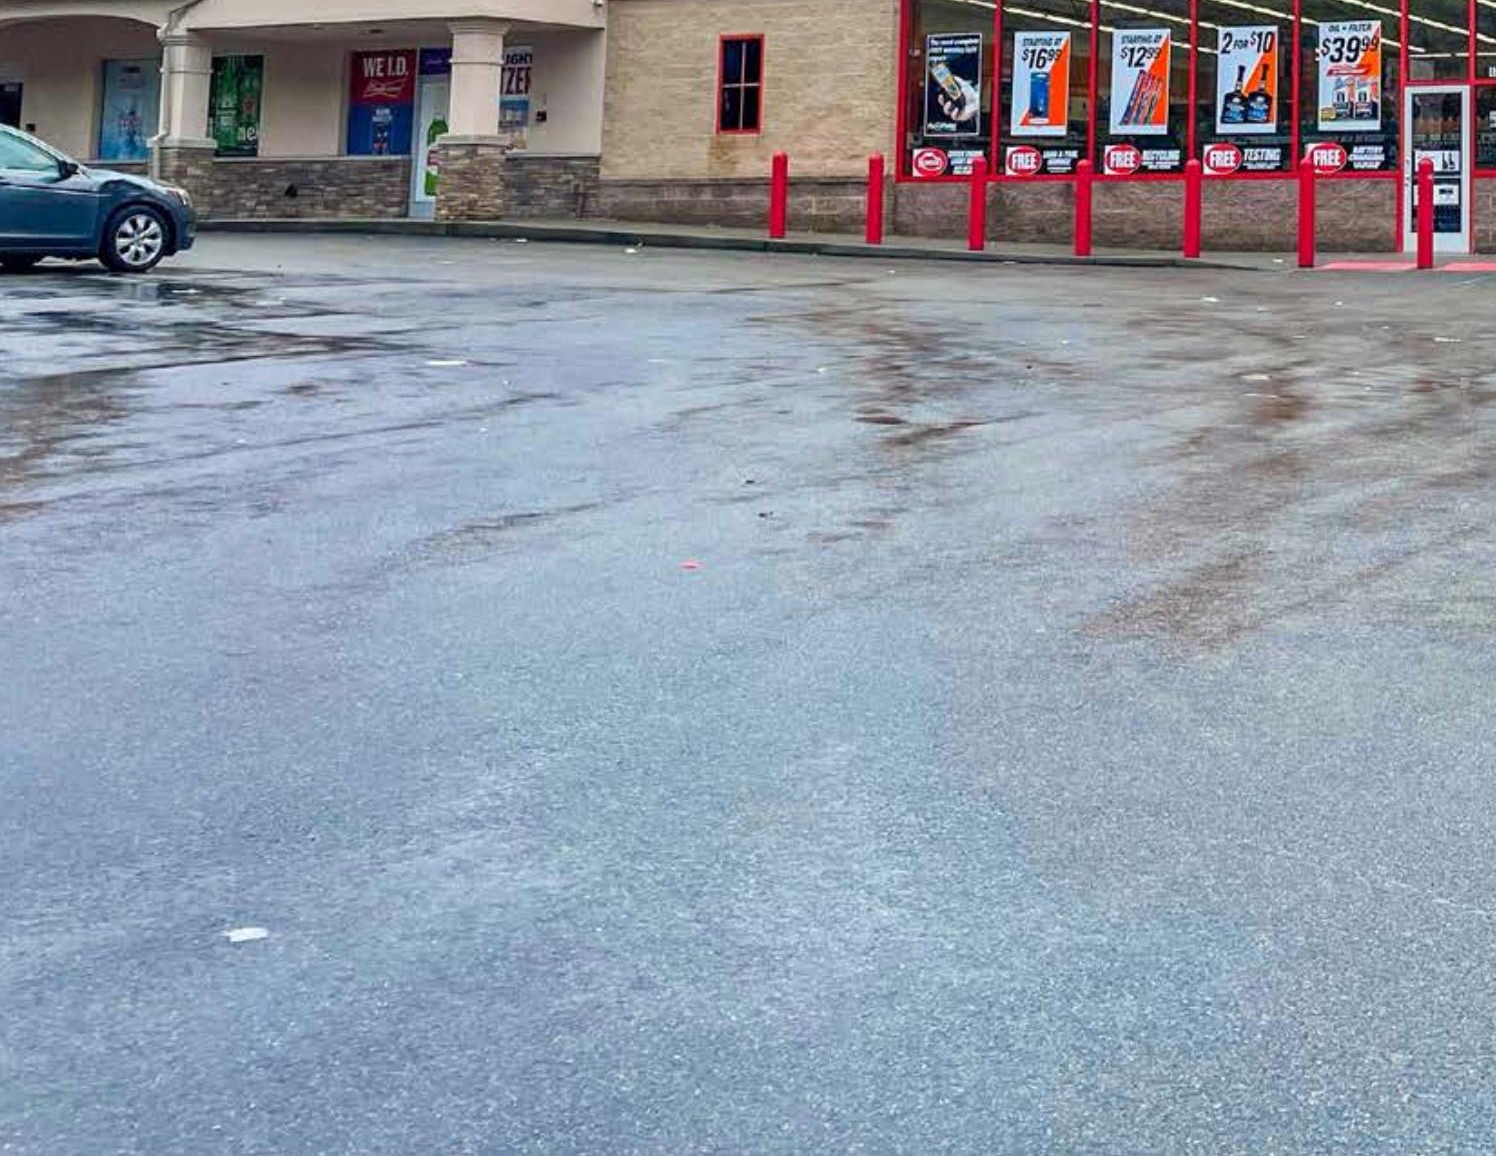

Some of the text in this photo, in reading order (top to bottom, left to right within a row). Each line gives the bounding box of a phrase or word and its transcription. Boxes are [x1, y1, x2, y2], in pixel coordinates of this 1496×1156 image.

[362, 55, 409, 78] WE I.D.
[1012, 152, 1037, 170] FREE
[1110, 150, 1136, 168] FREE
[1209, 150, 1237, 167] FREE
[1314, 149, 1341, 166] FREE
